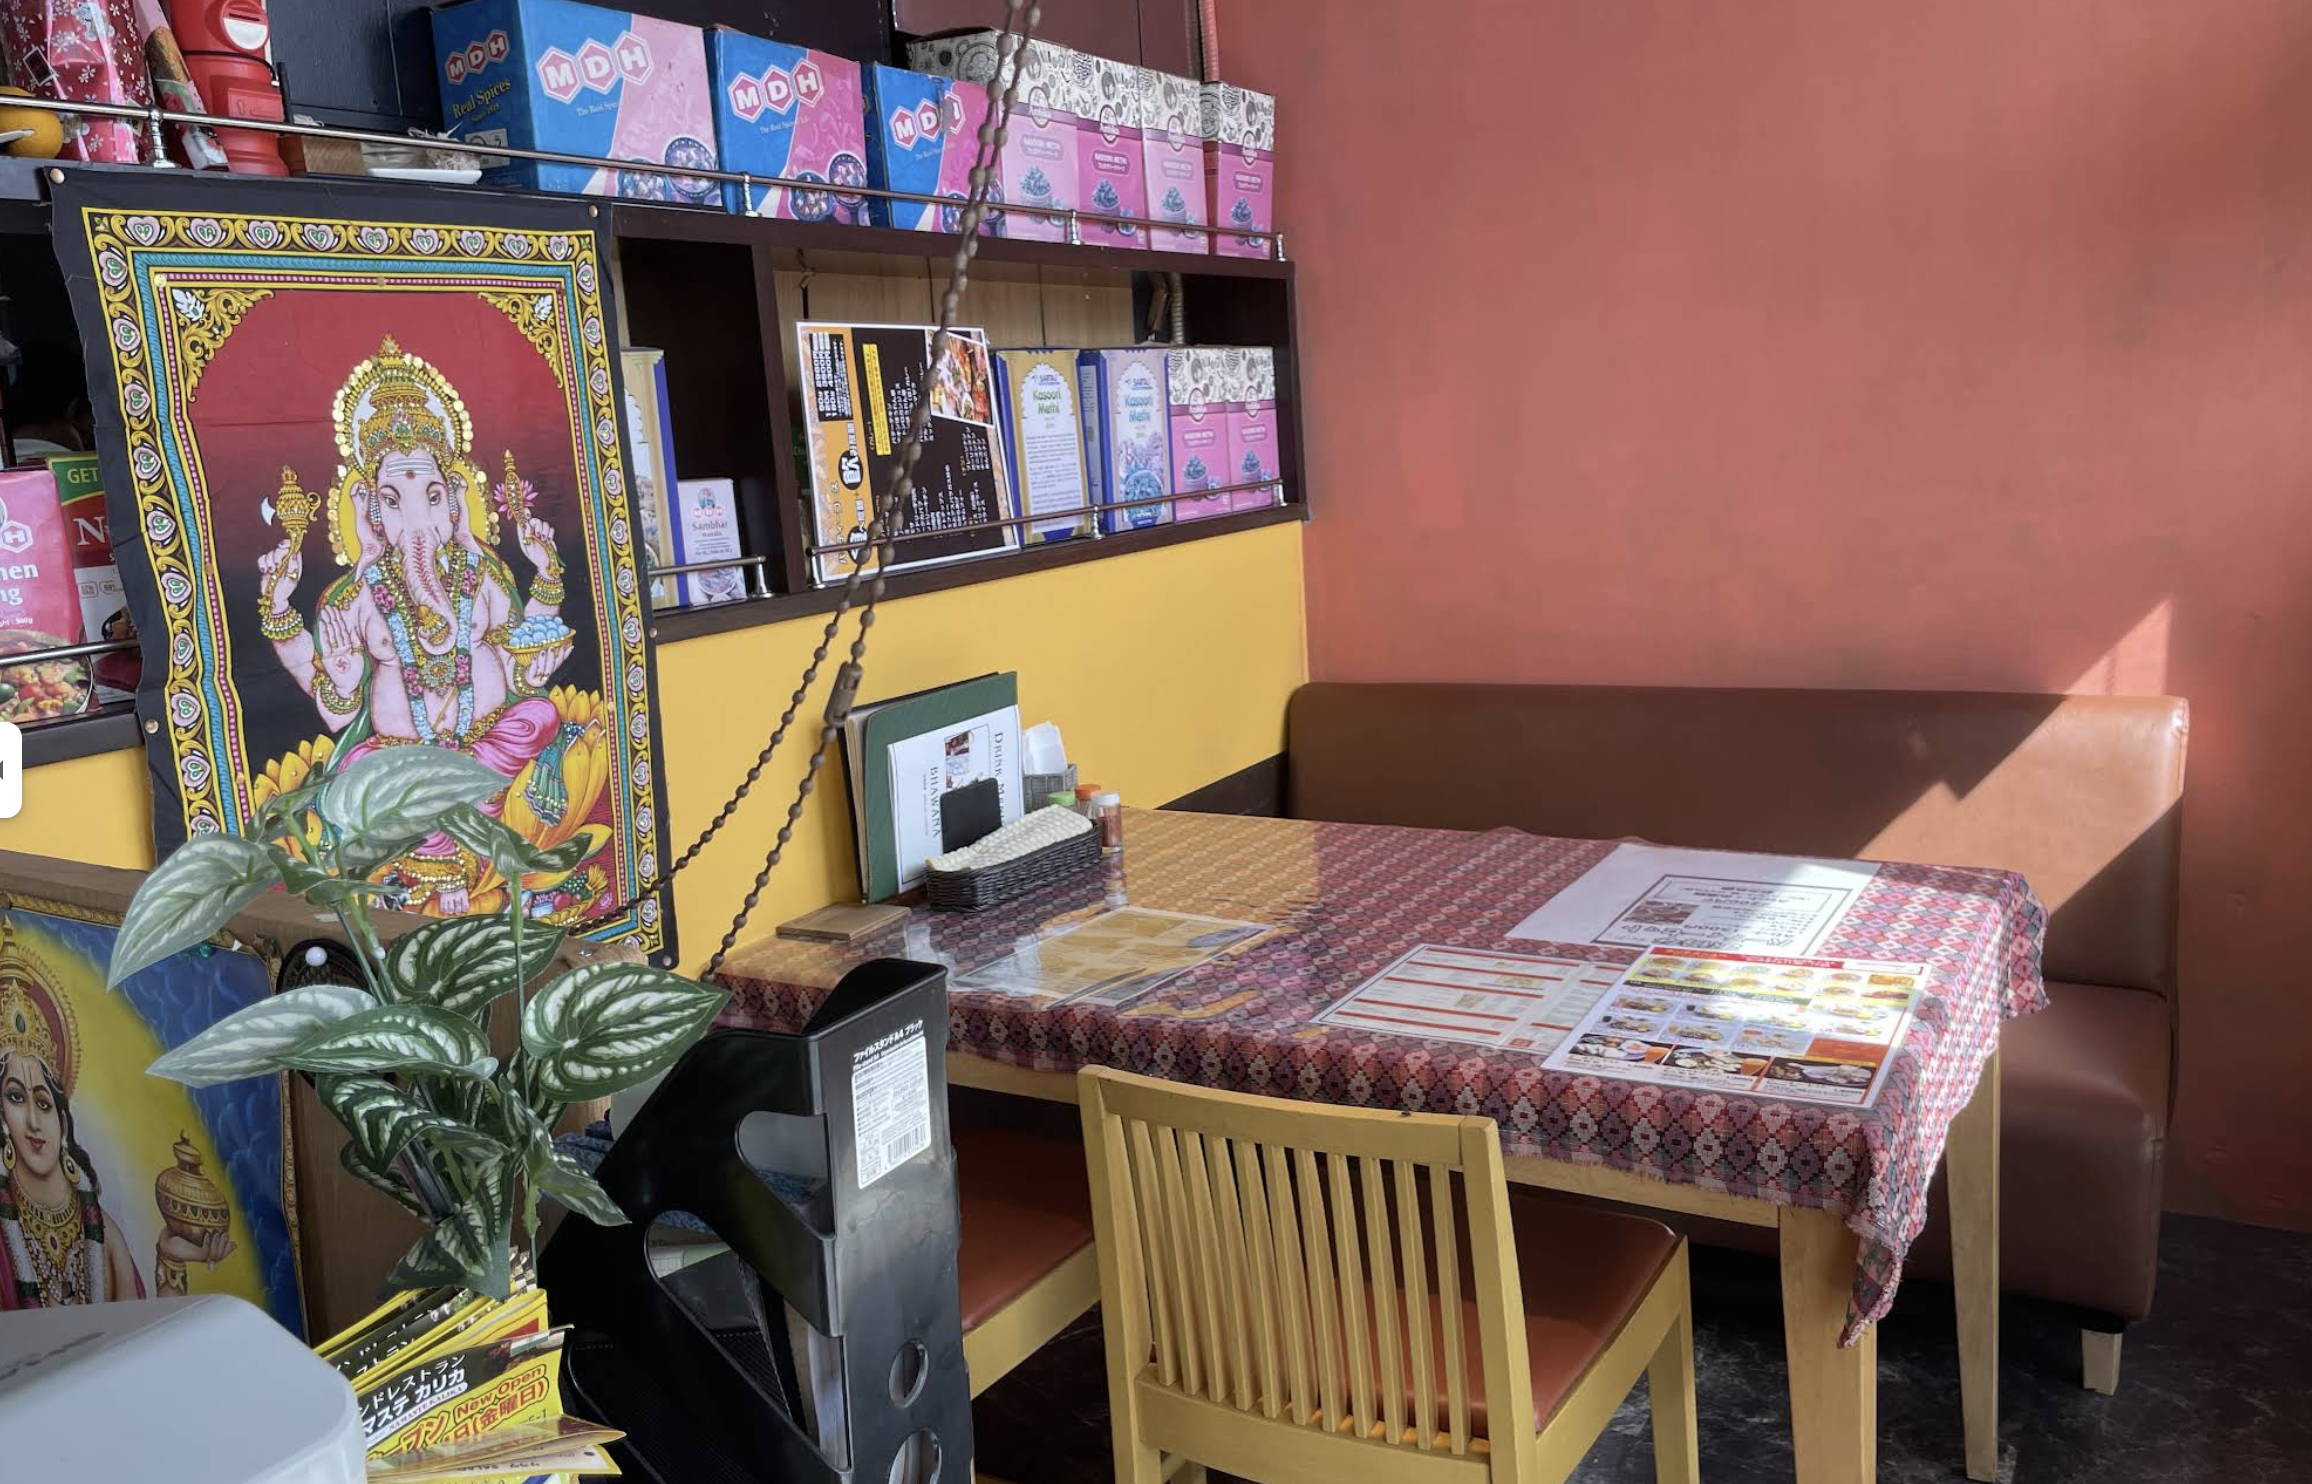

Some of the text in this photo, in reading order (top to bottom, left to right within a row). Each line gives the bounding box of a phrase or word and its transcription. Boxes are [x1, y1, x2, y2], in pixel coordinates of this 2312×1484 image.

[448, 36, 506, 79] MDH
[542, 40, 651, 96] MDH
[452, 78, 512, 119] Real Spices
[730, 65, 821, 115] MDH
[1038, 403, 1060, 415] Methi
[1129, 409, 1151, 422] Methi
[67, 467, 98, 484] GET
[691, 519, 728, 531] Sambhar
[994, 731, 1004, 778] DRINK
[930, 766, 941, 838] BHAWANA
[414, 1367, 466, 1405] カリカ
[429, 1386, 464, 1406] KALIKA
[456, 1366, 543, 1419] New Open
